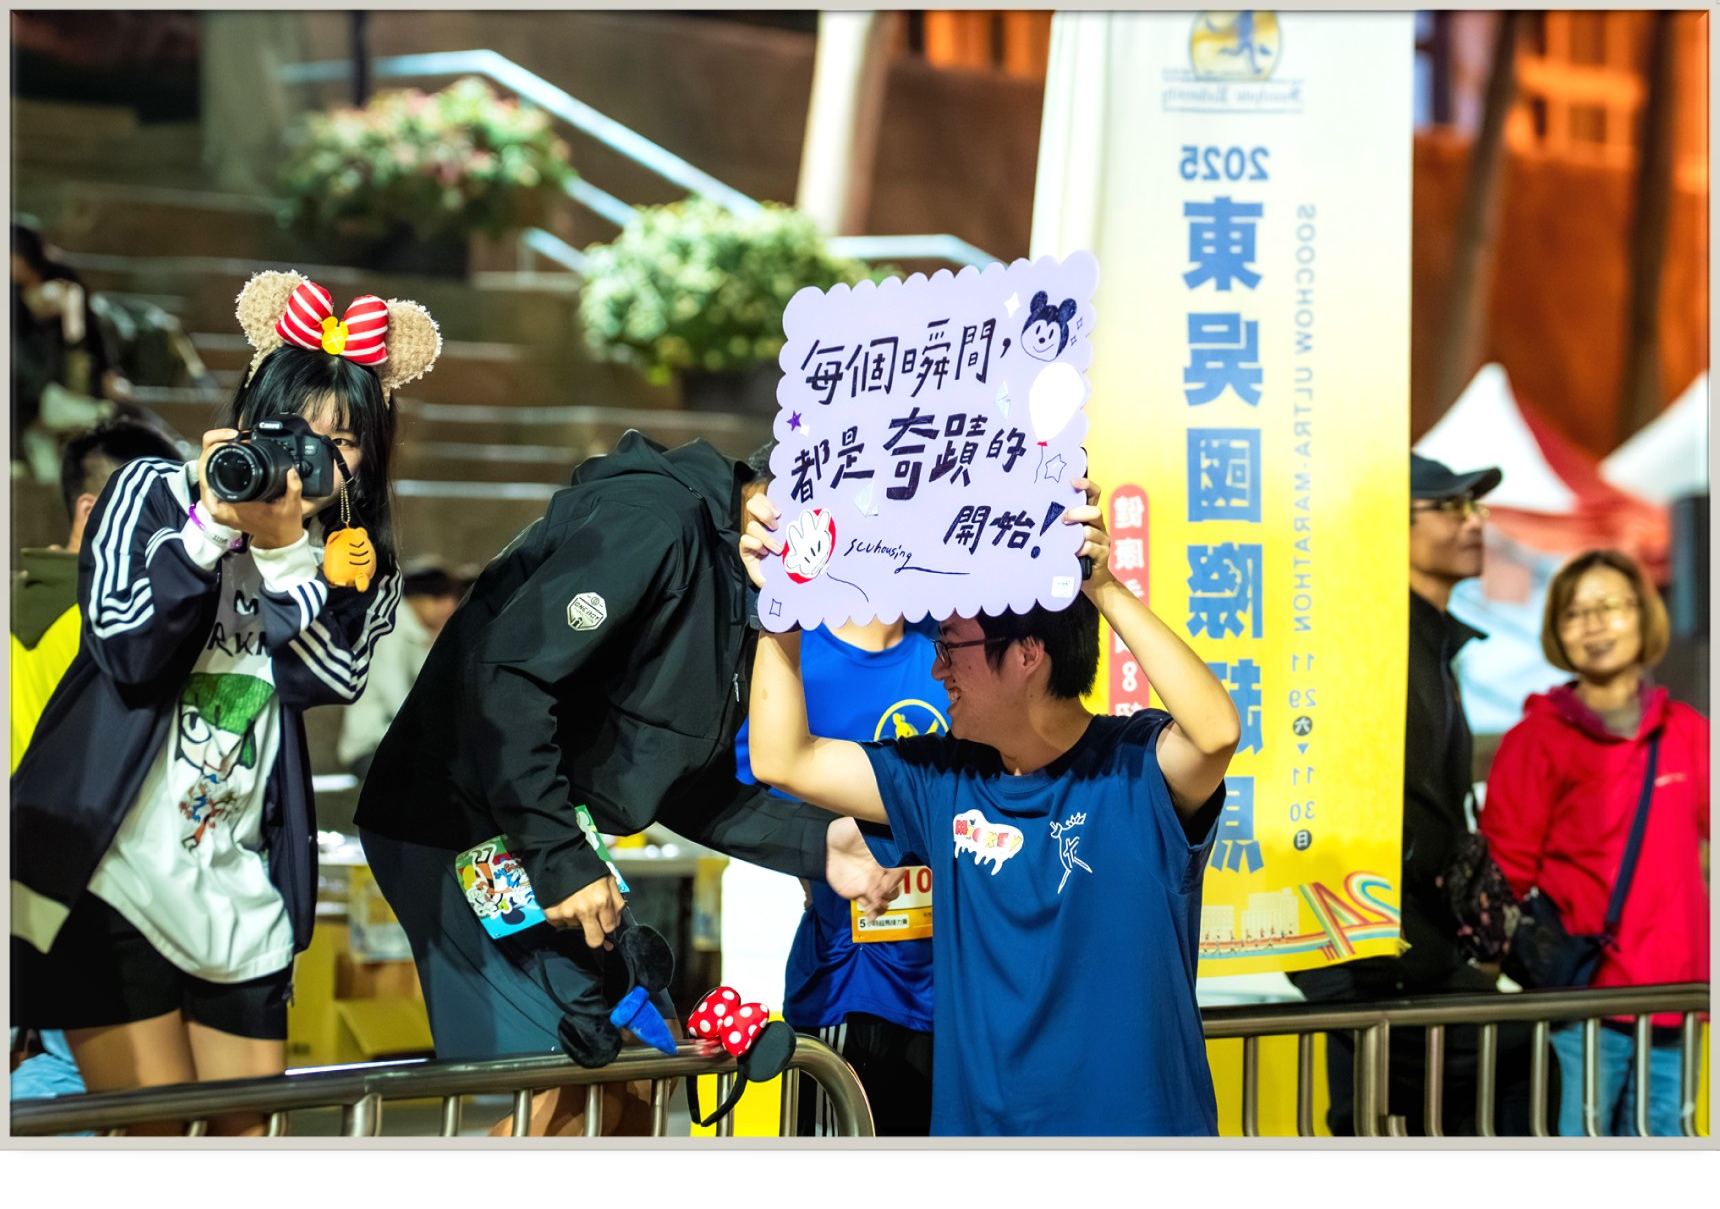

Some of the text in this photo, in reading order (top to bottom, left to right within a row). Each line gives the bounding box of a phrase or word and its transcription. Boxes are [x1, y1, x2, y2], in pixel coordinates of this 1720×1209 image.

[790, 407, 1026, 503] 都是奇蹟的
